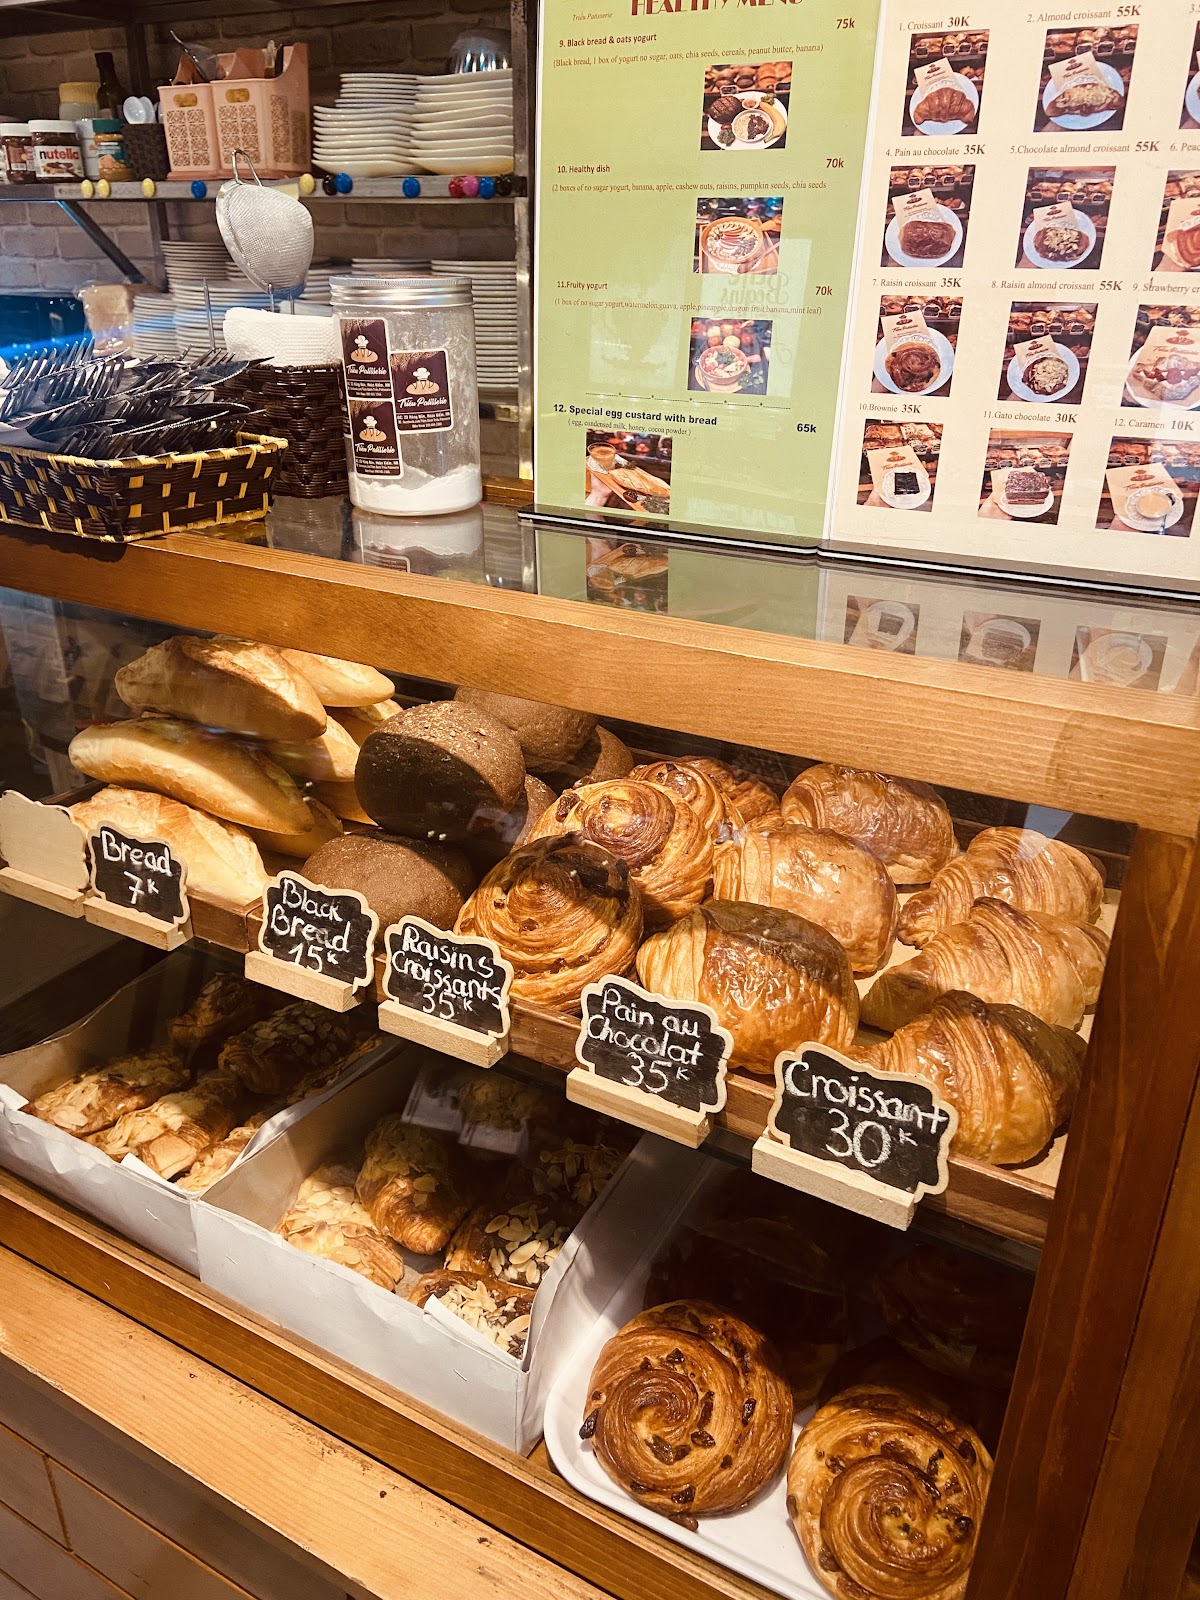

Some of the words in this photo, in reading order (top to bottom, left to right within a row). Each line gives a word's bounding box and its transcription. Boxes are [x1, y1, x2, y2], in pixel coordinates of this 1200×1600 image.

[1026, 13, 1035, 23] 2.
[1036, 11, 1071, 22] Almond
[1073, 9, 1112, 20] croissant
[1116, 5, 1142, 17] 55K
[836, 18, 855, 29] 75k
[899, 22, 905, 31] 1.
[907, 21, 943, 30] Croissant
[947, 16, 970, 28] 30K
[559, 39, 566, 48] 9.
[567, 37, 585, 47] Black
[586, 36, 607, 46] bread
[608, 36, 615, 44] &
[616, 36, 632, 44] oats
[633, 34, 657, 44] yogurt
[553, 59, 572, 68] (Black
[574, 58, 592, 66] bread,
[598, 56, 610, 64] box
[611, 55, 619, 63] of
[618, 55, 639, 64] yogurt
[649, 54, 668, 62] sugar,
[669, 52, 684, 60] oats,
[686, 51, 699, 59] chia
[701, 49, 720, 58] seeds,
[721, 47, 747, 57] cereals,
[748, 46, 771, 57] peanut
[772, 44, 794, 54] butter,
[795, 42, 824, 53] banana)
[39, 147, 80, 160] nutella
[885, 148, 892, 157] 4.
[894, 148, 911, 157] Pain
[923, 147, 960, 156] chocolate
[963, 144, 986, 155] 35K
[1060, 144, 1091, 153] almond
[1093, 143, 1130, 153] croissant
[1135, 141, 1160, 152] 55K
[1170, 142, 1178, 152] 6.
[557, 165, 568, 174] 10.
[569, 165, 595, 174] Healthy
[596, 164, 611, 173] dish
[826, 158, 844, 168] 70k
[552, 184, 558, 192] (2
[560, 184, 576, 192] boxes
[576, 184, 584, 192] of
[609, 184, 630, 193] yogurt,
[631, 183, 654, 191] banana,
[675, 182, 699, 191] cashew
[700, 183, 715, 191] nuts,
[716, 182, 739, 191] raisins,
[740, 181, 769, 192] pumpkin
[770, 181, 791, 190] seeds,
[792, 181, 807, 189] chia
[808, 181, 827, 189] seeds
[586, 282, 608, 291] yogurt
[872, 278, 878, 287] 7.
[880, 278, 903, 287] Raisin
[904, 279, 937, 287] croissant
[940, 278, 962, 288] 35K
[991, 280, 999, 289] 8.
[1001, 280, 1026, 290] Raisin
[1027, 281, 1057, 290] almond
[1058, 281, 1095, 291] croissant
[1100, 280, 1124, 291] 55K
[1132, 283, 1140, 292] 9.
[1142, 283, 1190, 294] Strawberry
[815, 285, 833, 296] 70k
[553, 403, 567, 413] 12.
[569, 405, 603, 416] Special
[605, 409, 623, 420] egg
[625, 411, 662, 421] custard
[664, 413, 686, 423] with
[688, 415, 717, 426] bread
[901, 404, 922, 414] 35K
[1014, 412, 1051, 422] chocolate
[1055, 412, 1078, 424] 30K
[1114, 418, 1126, 428] 12.
[1170, 420, 1196, 431] 10K
[584, 420, 612, 429] condensed
[665, 427, 687, 435] powder
[796, 423, 817, 433] 65k
[101, 830, 173, 877] Bread
[282, 878, 344, 922] Black
[270, 903, 351, 953] Bread
[402, 926, 494, 979] Raisins
[391, 950, 502, 1010] Croissants
[601, 988, 655, 1025] Pain
[661, 1015, 701, 1038] au
[587, 1014, 704, 1066] Chocolat
[784, 1061, 949, 1135] Croissant
